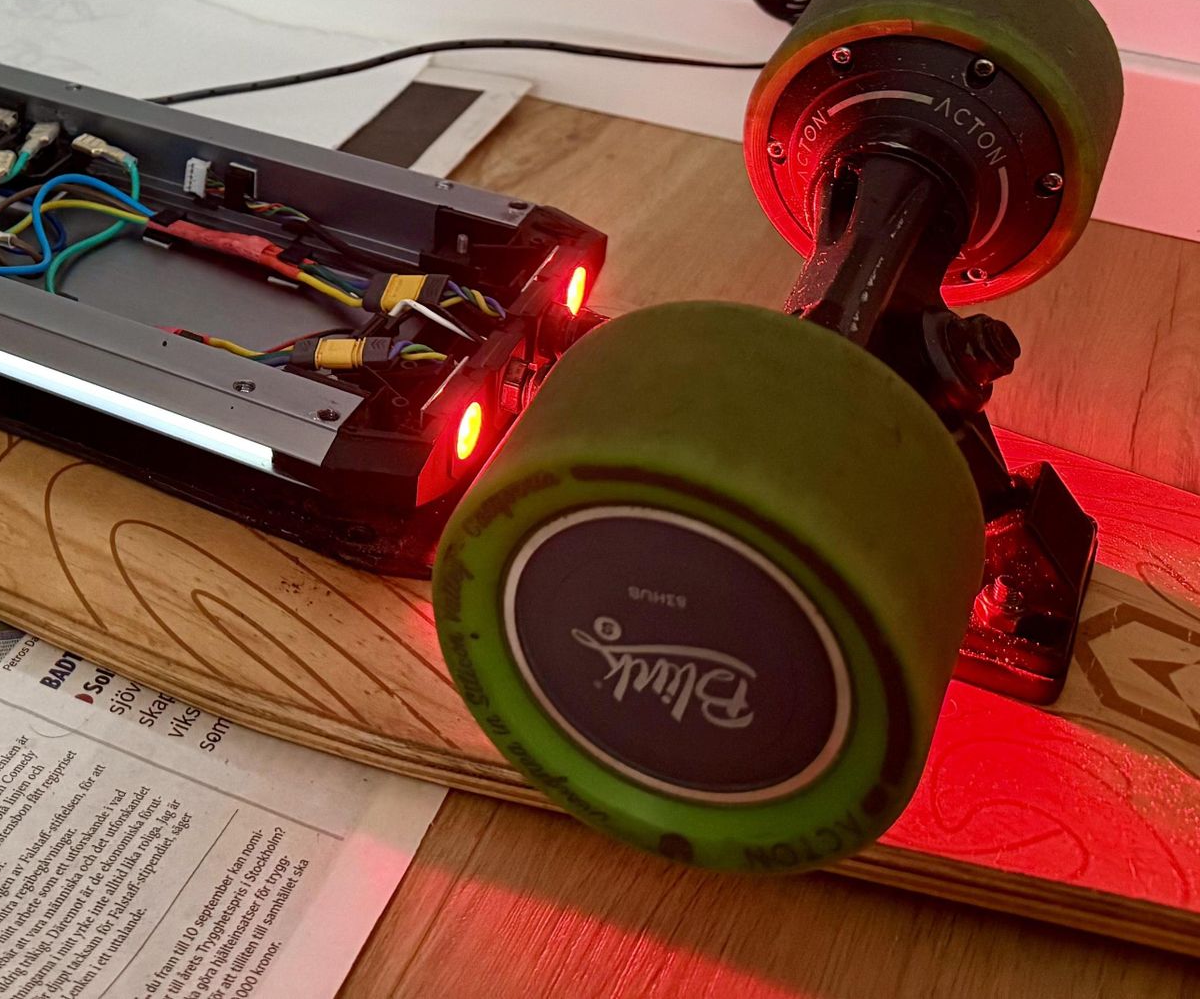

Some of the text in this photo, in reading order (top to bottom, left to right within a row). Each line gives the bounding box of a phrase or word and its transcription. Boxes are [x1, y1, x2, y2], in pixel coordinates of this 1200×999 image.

[934, 97, 1007, 166] ACTON
[2, 645, 30, 672] Petros
[2, 749, 38, 783] Comedy
[16, 734, 28, 745] är
[3, 780, 31, 805] linjen
[28, 765, 45, 780] och
[26, 787, 45, 804] fått
[42, 750, 77, 788] regipriset
[12, 863, 24, 876] av
[18, 792, 86, 863] Falstaff-stiftelsen,
[79, 776, 95, 791] för
[93, 764, 106, 777] att
[15, 828, 77, 900] regibegåvningar.
[16, 937, 30, 949] att
[26, 919, 47, 937] vara
[44, 872, 83, 919] människa
[80, 854, 97, 872] och
[92, 837, 109, 853] det
[105, 786, 150, 837] utforskandet
[146, 979, 161, 993] du
[154, 956, 179, 979] fram
[173, 939, 190, 955] till
[183, 927, 198, 941] 10
[195, 874, 233, 927] september
[227, 856, 247, 874] kan
[168, 979, 184, 993] till
[177, 954, 203, 980] årets
[195, 887, 247, 952] Trygghetspris
[244, 826, 285, 882] Stockholm?
[197, 855, 290, 991] göra hjälteinsatser för trygg-
[221, 859, 309, 989] att tilliten till samhället ska
[250, 941, 281, 975] kronor.
